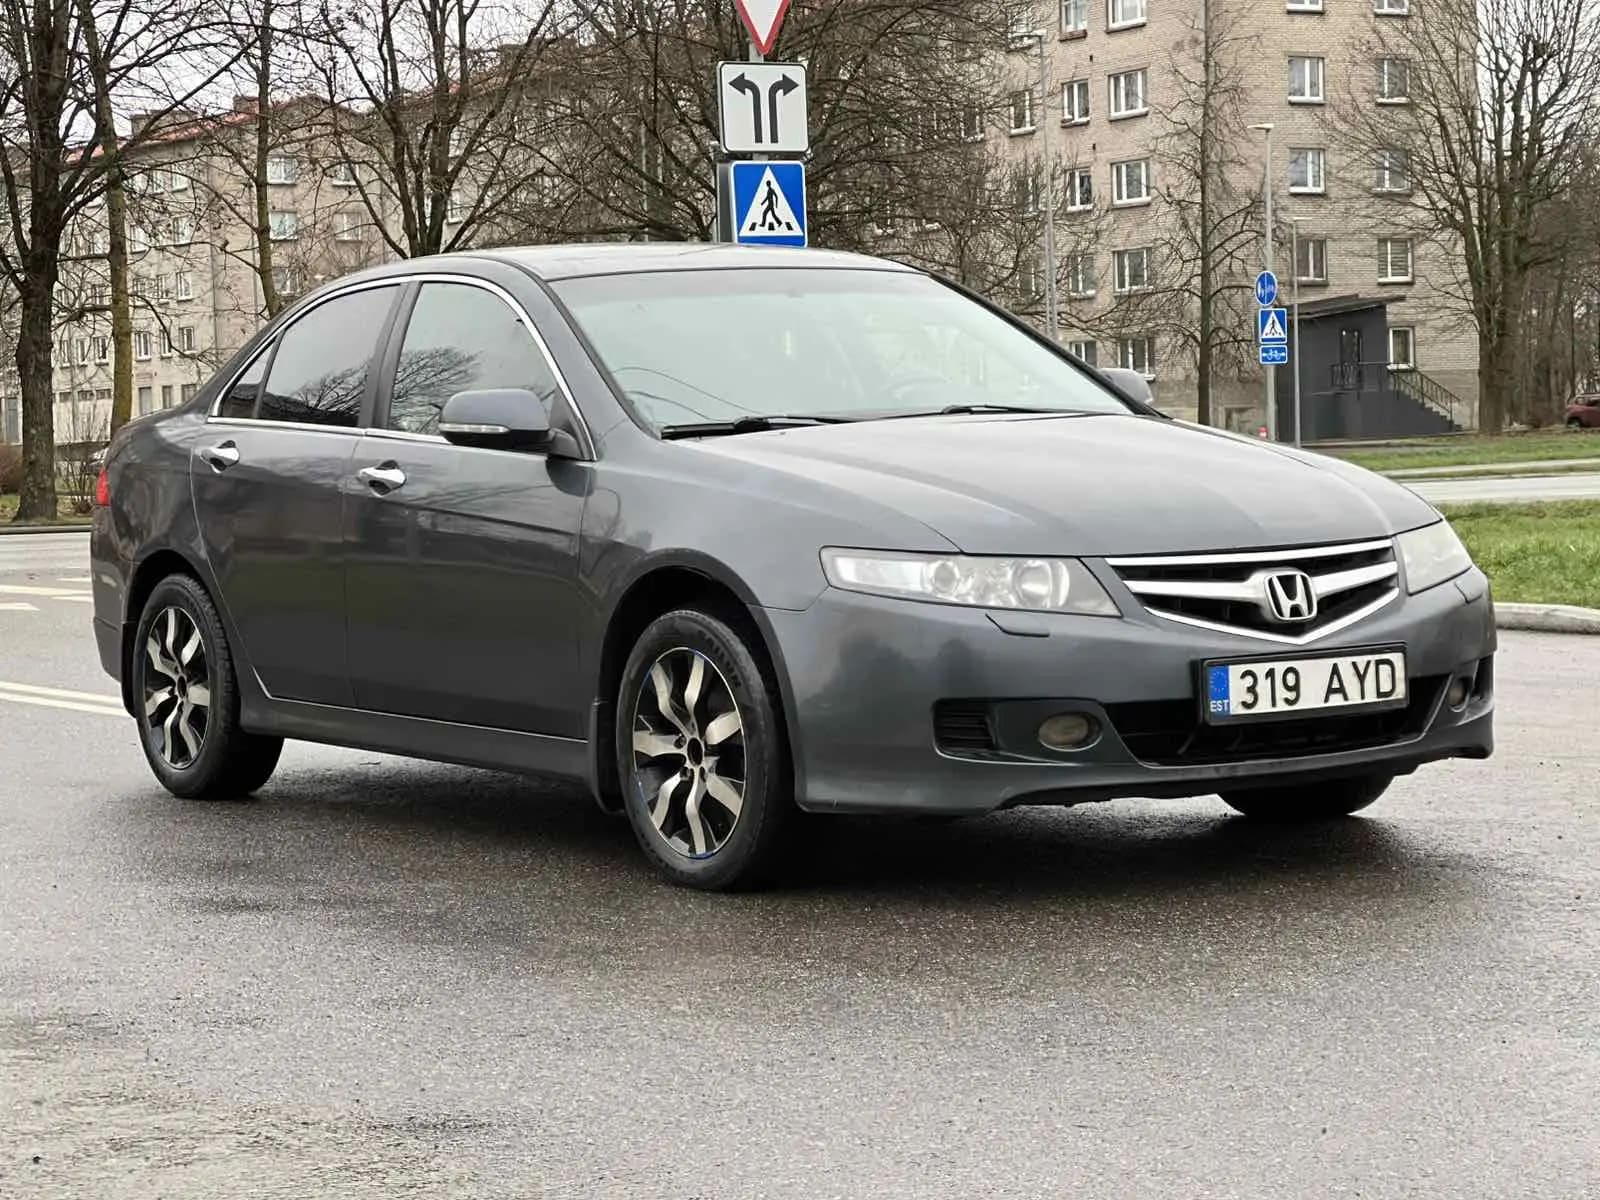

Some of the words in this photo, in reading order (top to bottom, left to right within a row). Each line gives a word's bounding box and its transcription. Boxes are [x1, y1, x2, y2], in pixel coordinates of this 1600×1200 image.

[1239, 666, 1301, 710] 319
[1323, 658, 1397, 704] AYD
[1210, 699, 1229, 712] EST
